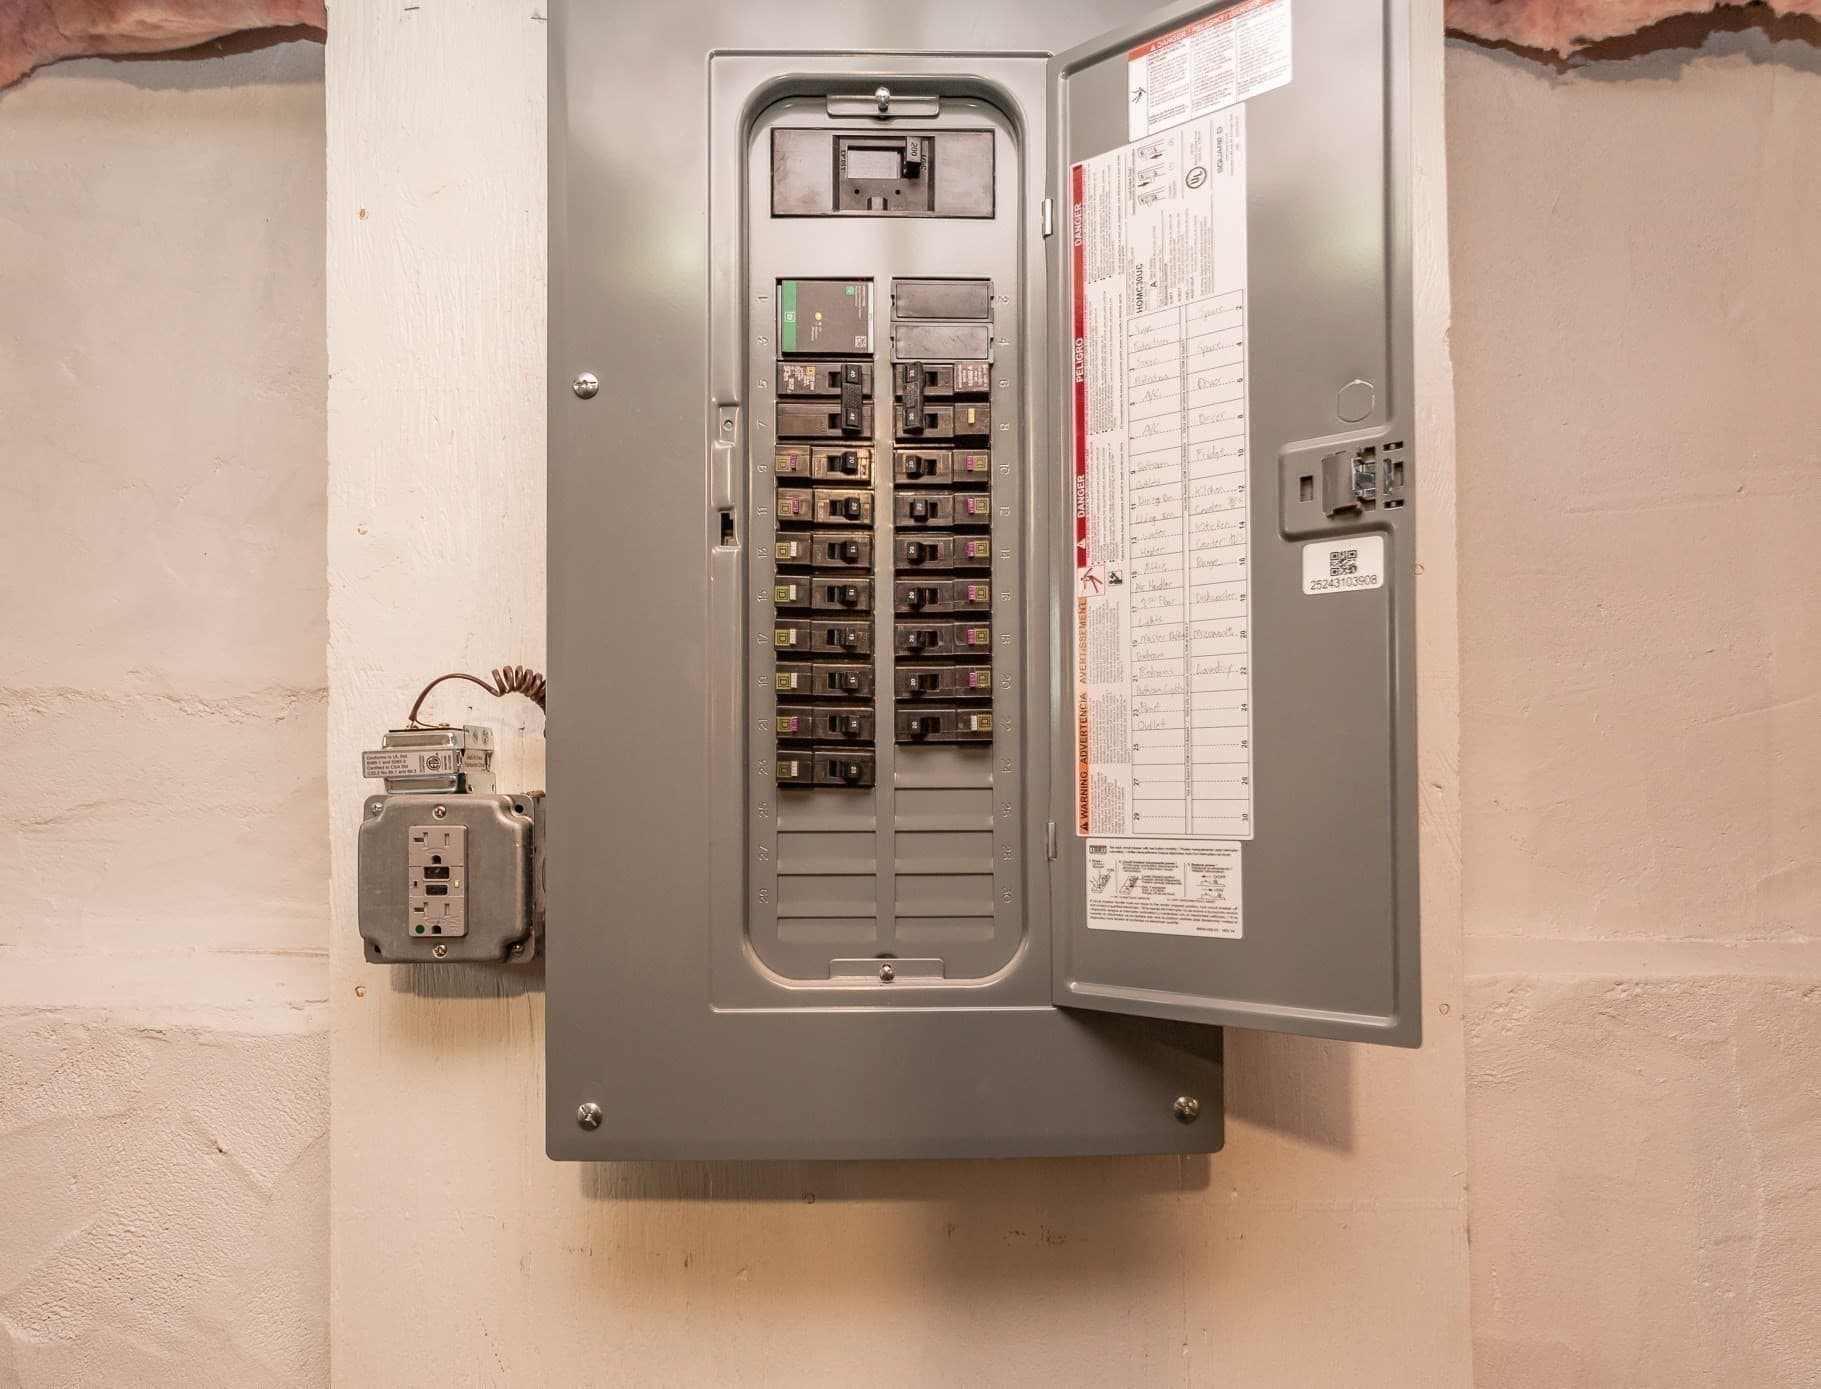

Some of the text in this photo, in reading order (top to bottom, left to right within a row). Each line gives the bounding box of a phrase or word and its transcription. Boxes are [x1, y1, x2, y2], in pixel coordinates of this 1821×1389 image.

[910, 142, 918, 157] 200
[1215, 137, 1224, 173] SQUARE
[1074, 202, 1083, 247] DANGER
[1135, 263, 1144, 314] HOMC30UC
[1075, 337, 1084, 383] PELIGRO
[1076, 473, 1086, 519] DANGER
[1078, 601, 1087, 684] AVERTISSEMENT
[1079, 692, 1088, 764] ADVERTENCIA
[1079, 771, 1089, 819] WARNING
